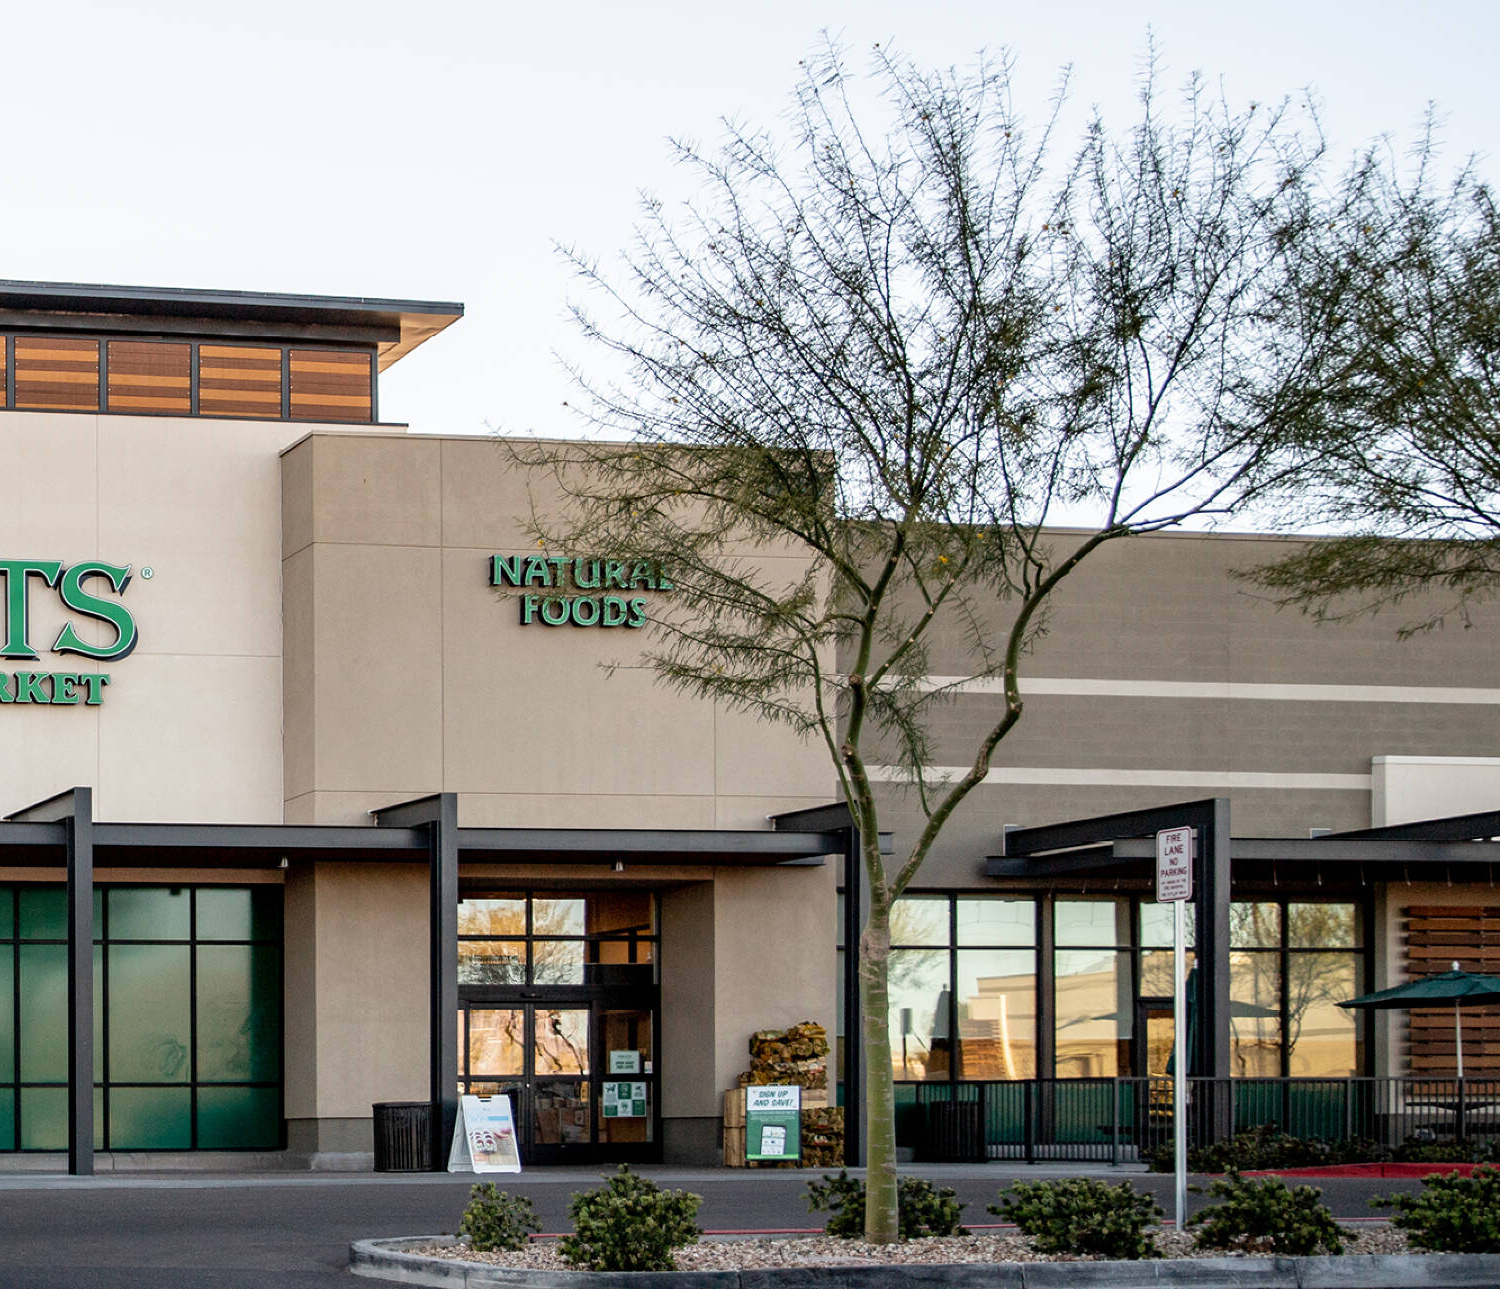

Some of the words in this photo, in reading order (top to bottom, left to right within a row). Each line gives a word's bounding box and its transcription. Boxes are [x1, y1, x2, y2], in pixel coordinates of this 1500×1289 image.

[490, 555, 675, 591] NATURAL
[521, 593, 648, 628] FOODS
[1166, 833, 1182, 844] FIRE
[1164, 844, 1184, 856] LANE
[1169, 857, 1178, 866] NO
[1160, 866, 1188, 878] PARKING
[759, 1090, 775, 1098] SIGN
[778, 1090, 788, 1098] UP
[753, 1099, 769, 1107] AND
